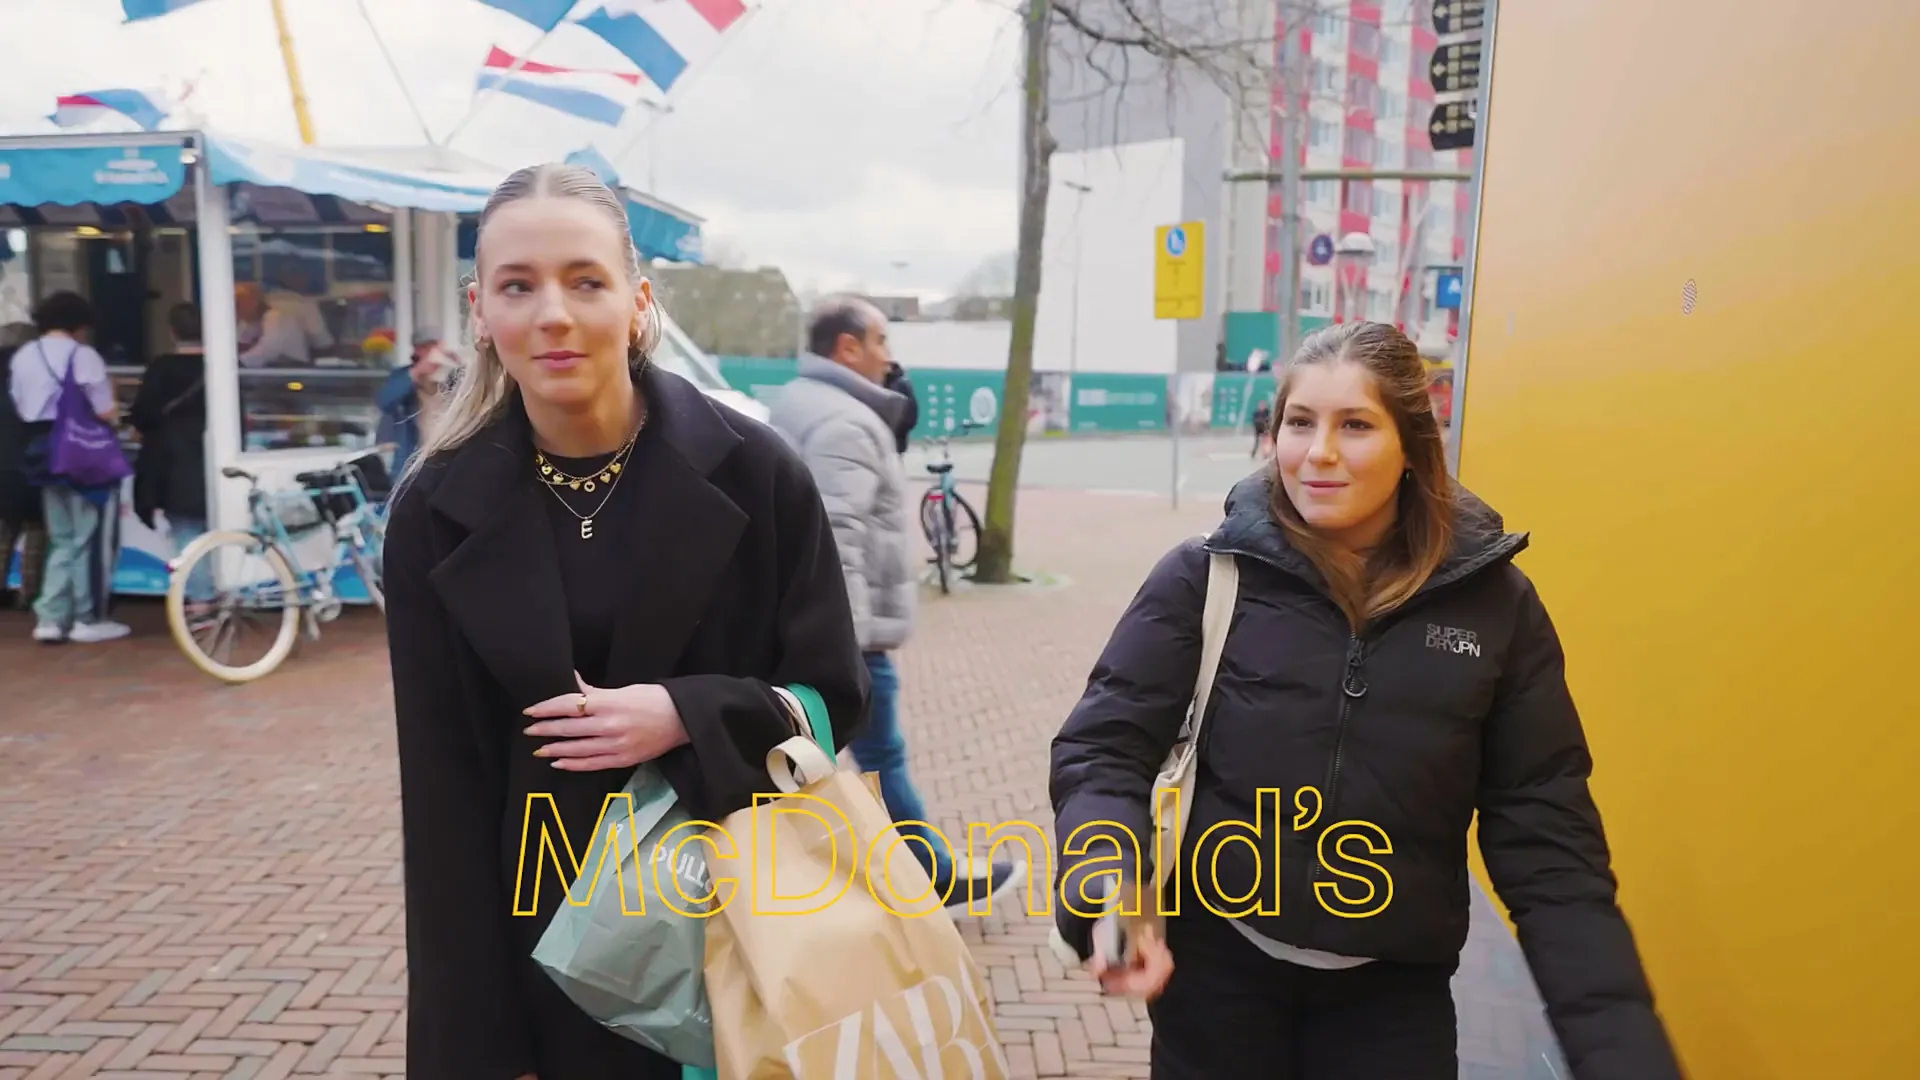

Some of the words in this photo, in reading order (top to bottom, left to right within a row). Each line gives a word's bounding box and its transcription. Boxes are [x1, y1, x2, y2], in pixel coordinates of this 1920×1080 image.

[1426, 623, 1478, 644] SUPER
[648, 842, 706, 889] PULL
[783, 956, 1010, 1080] ZARA
